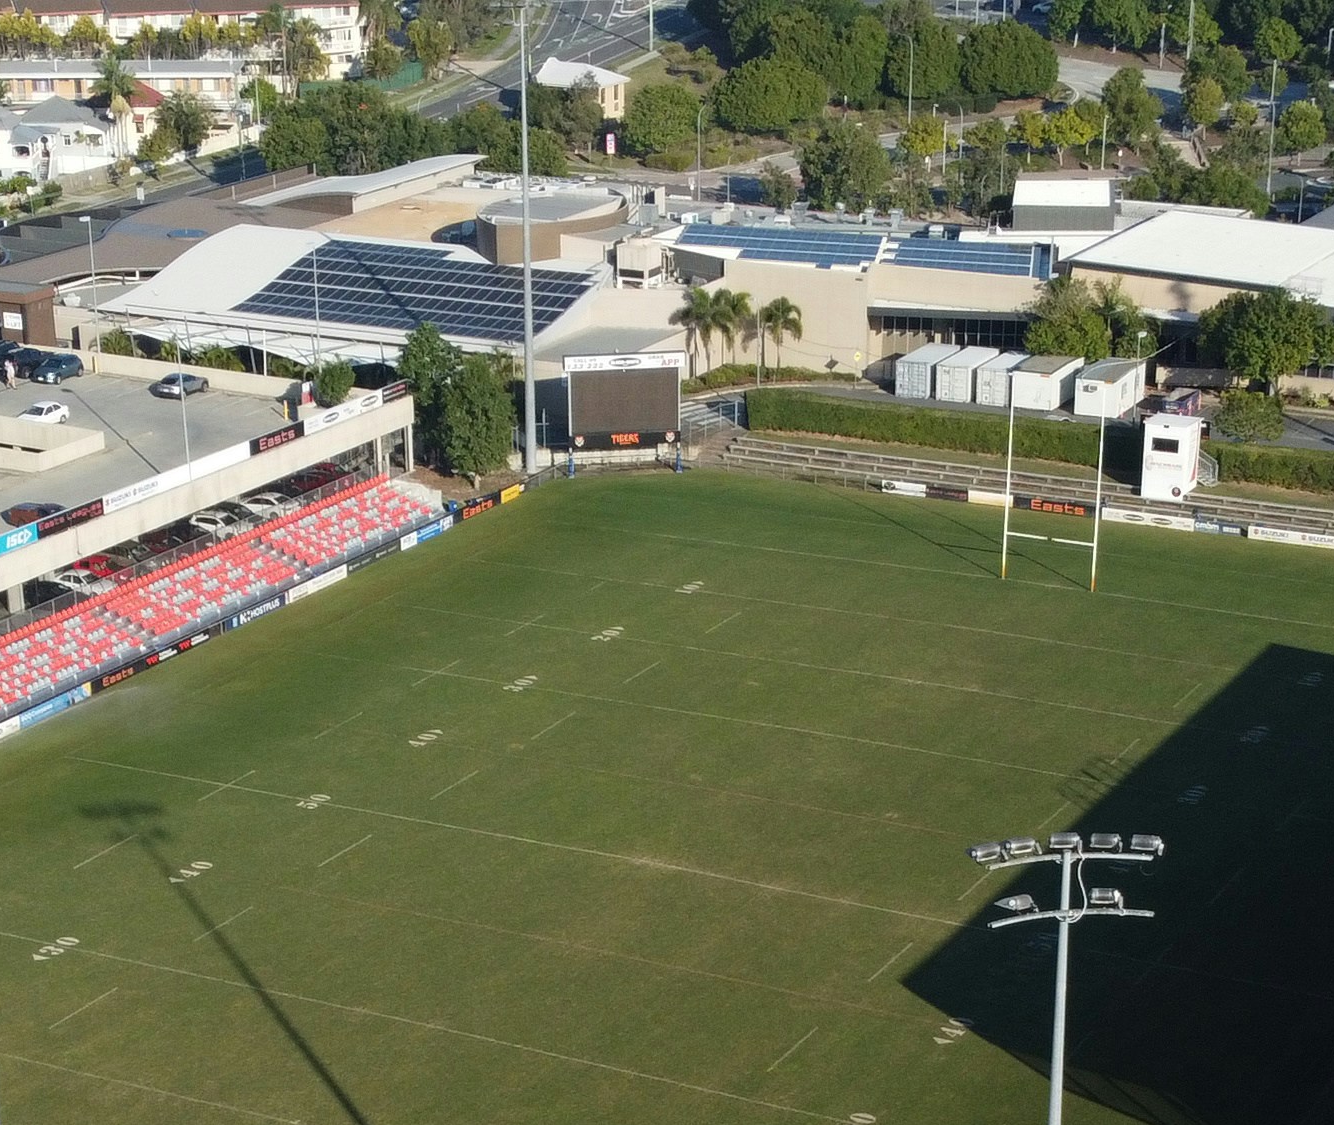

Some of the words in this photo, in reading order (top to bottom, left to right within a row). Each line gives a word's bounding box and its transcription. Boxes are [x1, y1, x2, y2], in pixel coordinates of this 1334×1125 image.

[661, 358, 680, 366] APP
[258, 428, 295, 451] Easts
[610, 433, 640, 444] TIGERS
[463, 500, 493, 520] Easts
[1030, 497, 1086, 516] Easts
[1260, 529, 1290, 539] SUZUKI
[250, 598, 280, 619] HOSTPLUS
[102, 666, 135, 687] Easts
